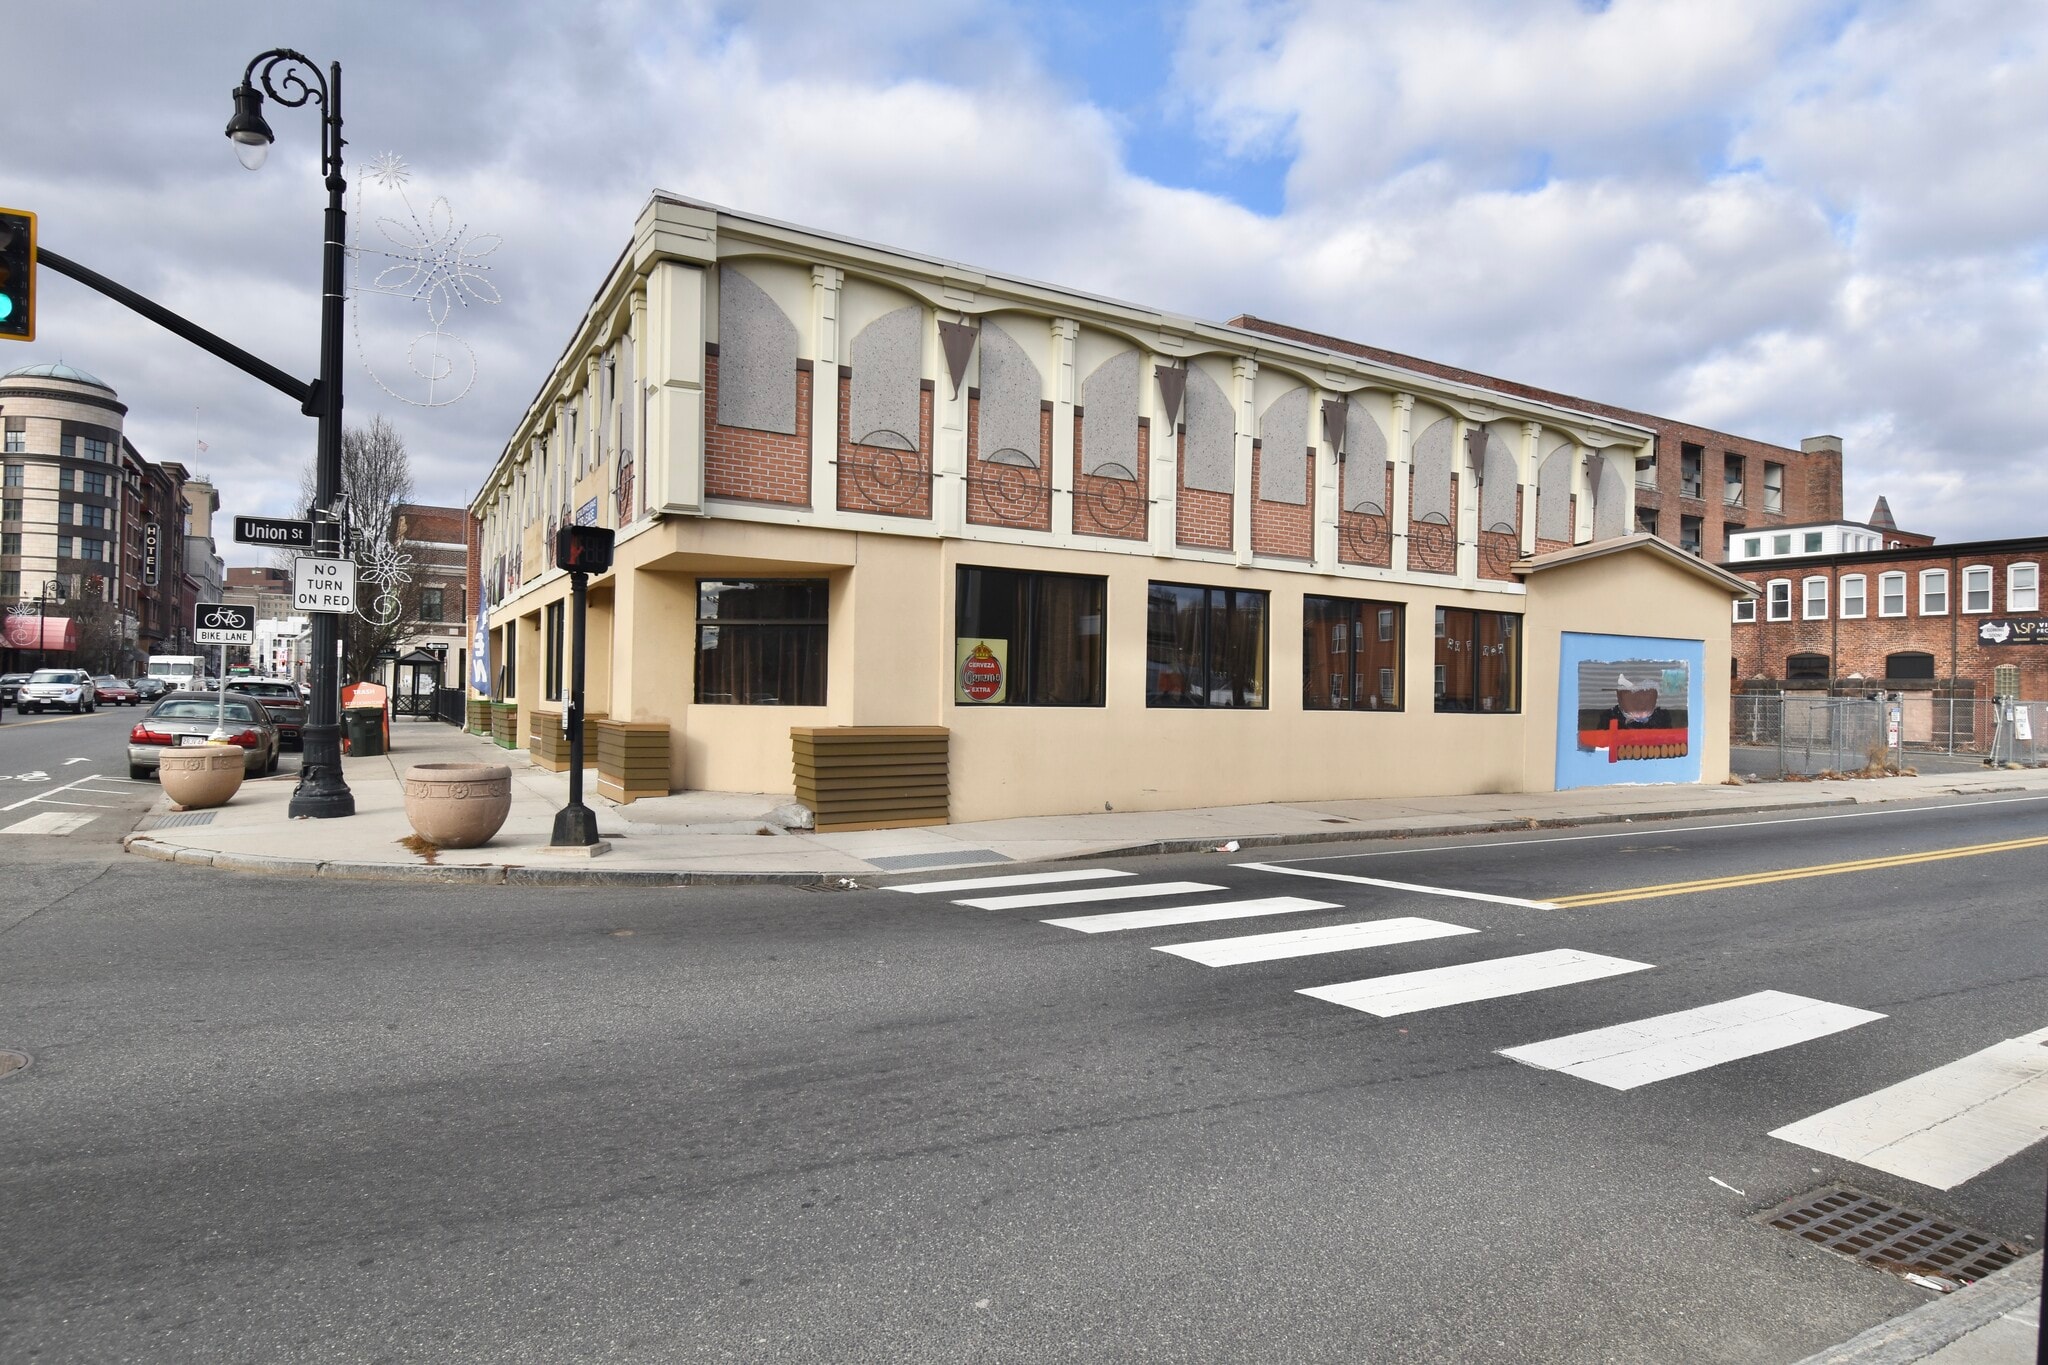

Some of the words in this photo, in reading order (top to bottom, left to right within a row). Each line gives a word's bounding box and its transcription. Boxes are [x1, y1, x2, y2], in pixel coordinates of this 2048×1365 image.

[245, 522, 287, 540] Union
[291, 528, 303, 540] St
[146, 527, 156, 575] HOTEL
[315, 565, 337, 576] NO
[307, 579, 343, 591] TURN
[299, 594, 317, 604] ON
[324, 595, 350, 606] RED
[201, 632, 221, 640] BIKE
[225, 632, 248, 641] LANE
